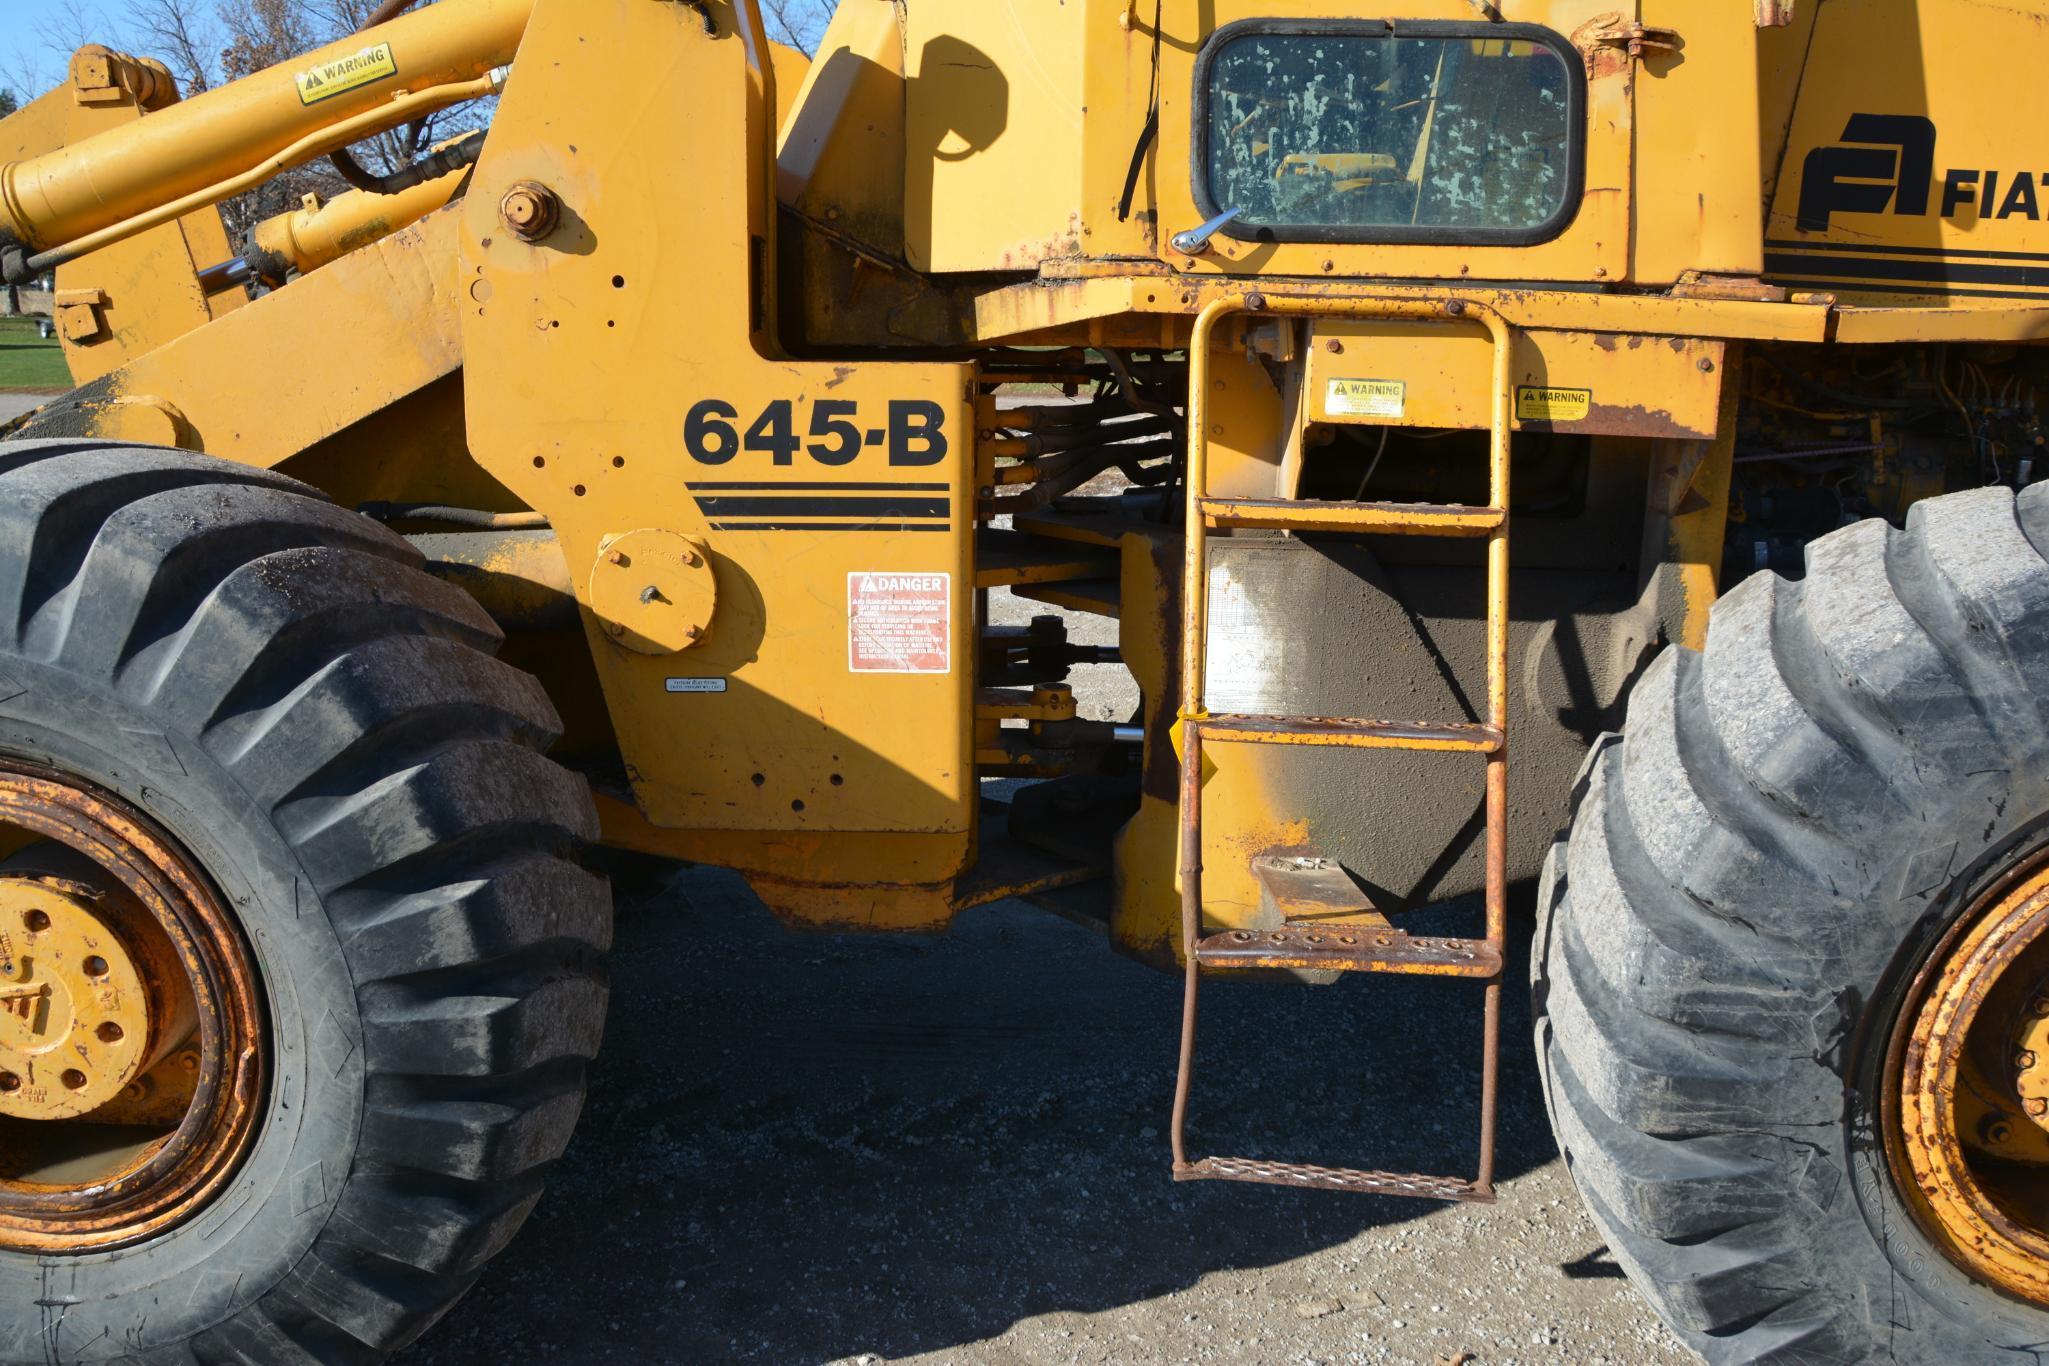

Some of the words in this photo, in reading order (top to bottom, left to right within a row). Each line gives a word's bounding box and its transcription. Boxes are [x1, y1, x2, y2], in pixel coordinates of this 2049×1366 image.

[323, 49, 385, 79] WARNING
[1940, 169, 2049, 222] FIA
[1350, 383, 1400, 396] WARNING
[1538, 391, 1585, 403] WARNING
[683, 399, 948, 466] 645-B
[878, 577, 942, 591] DANGER
